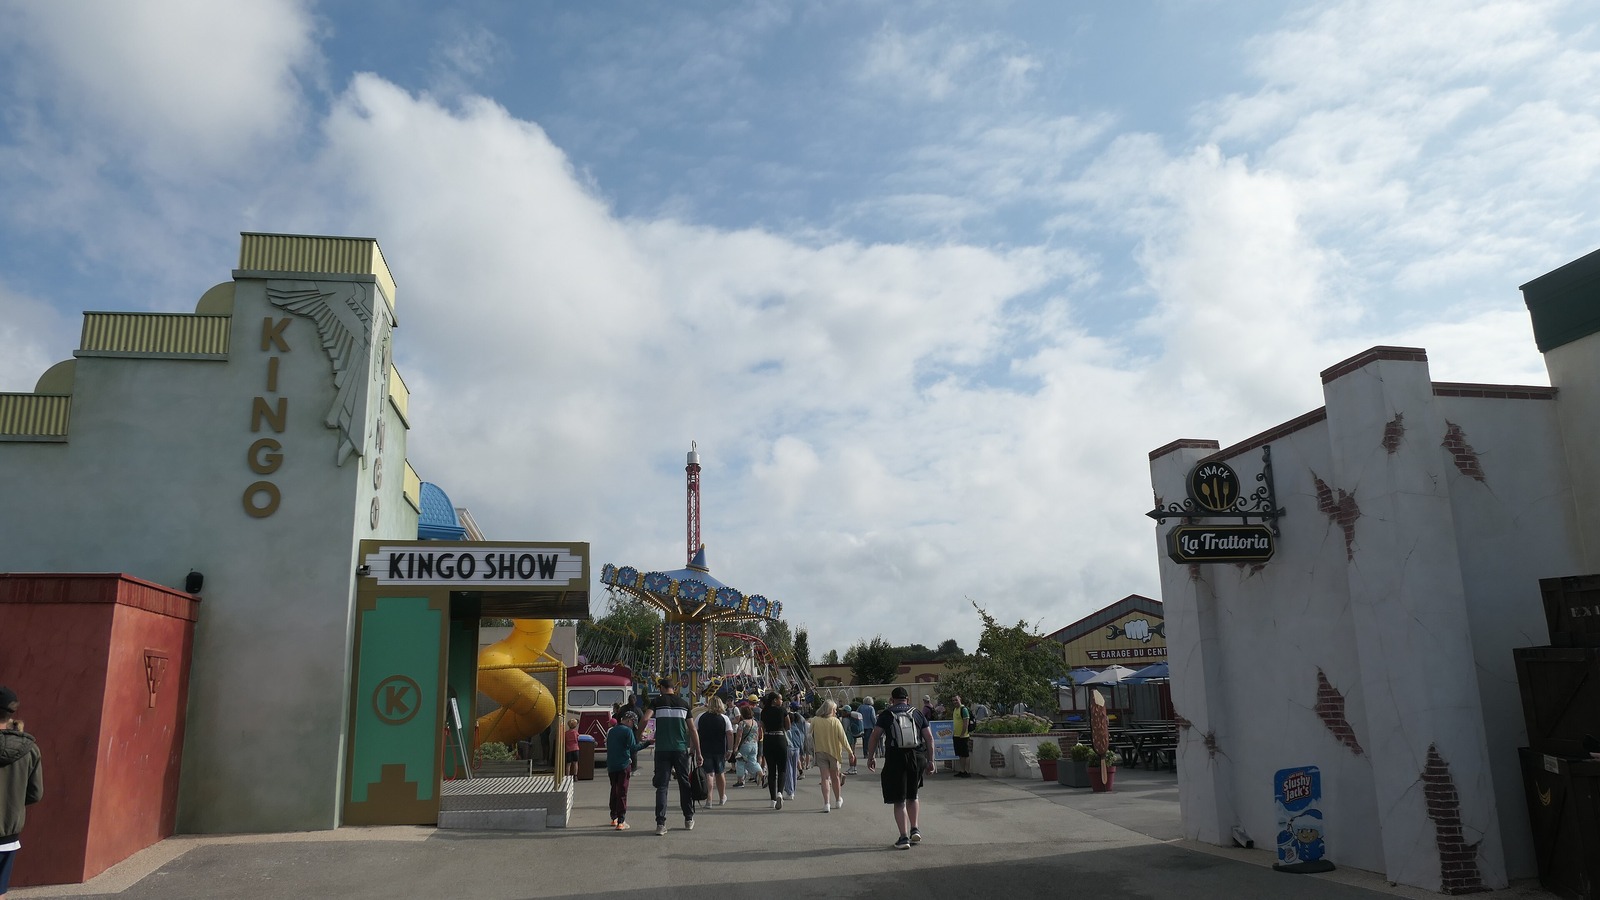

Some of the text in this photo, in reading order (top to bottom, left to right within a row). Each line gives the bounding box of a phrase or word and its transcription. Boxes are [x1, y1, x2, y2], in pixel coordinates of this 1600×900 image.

[242, 317, 293, 518] KINGO
[1199, 465, 1230, 479] SNACK
[1181, 533, 1269, 554] La Trattoria
[388, 552, 559, 579] KINGO SHOW
[1101, 650, 1131, 658] GARAGE
[1134, 649, 1144, 657] DU
[385, 686, 411, 715] K
[1283, 775, 1311, 792] Slushy
[1286, 785, 1309, 802] Jack's
